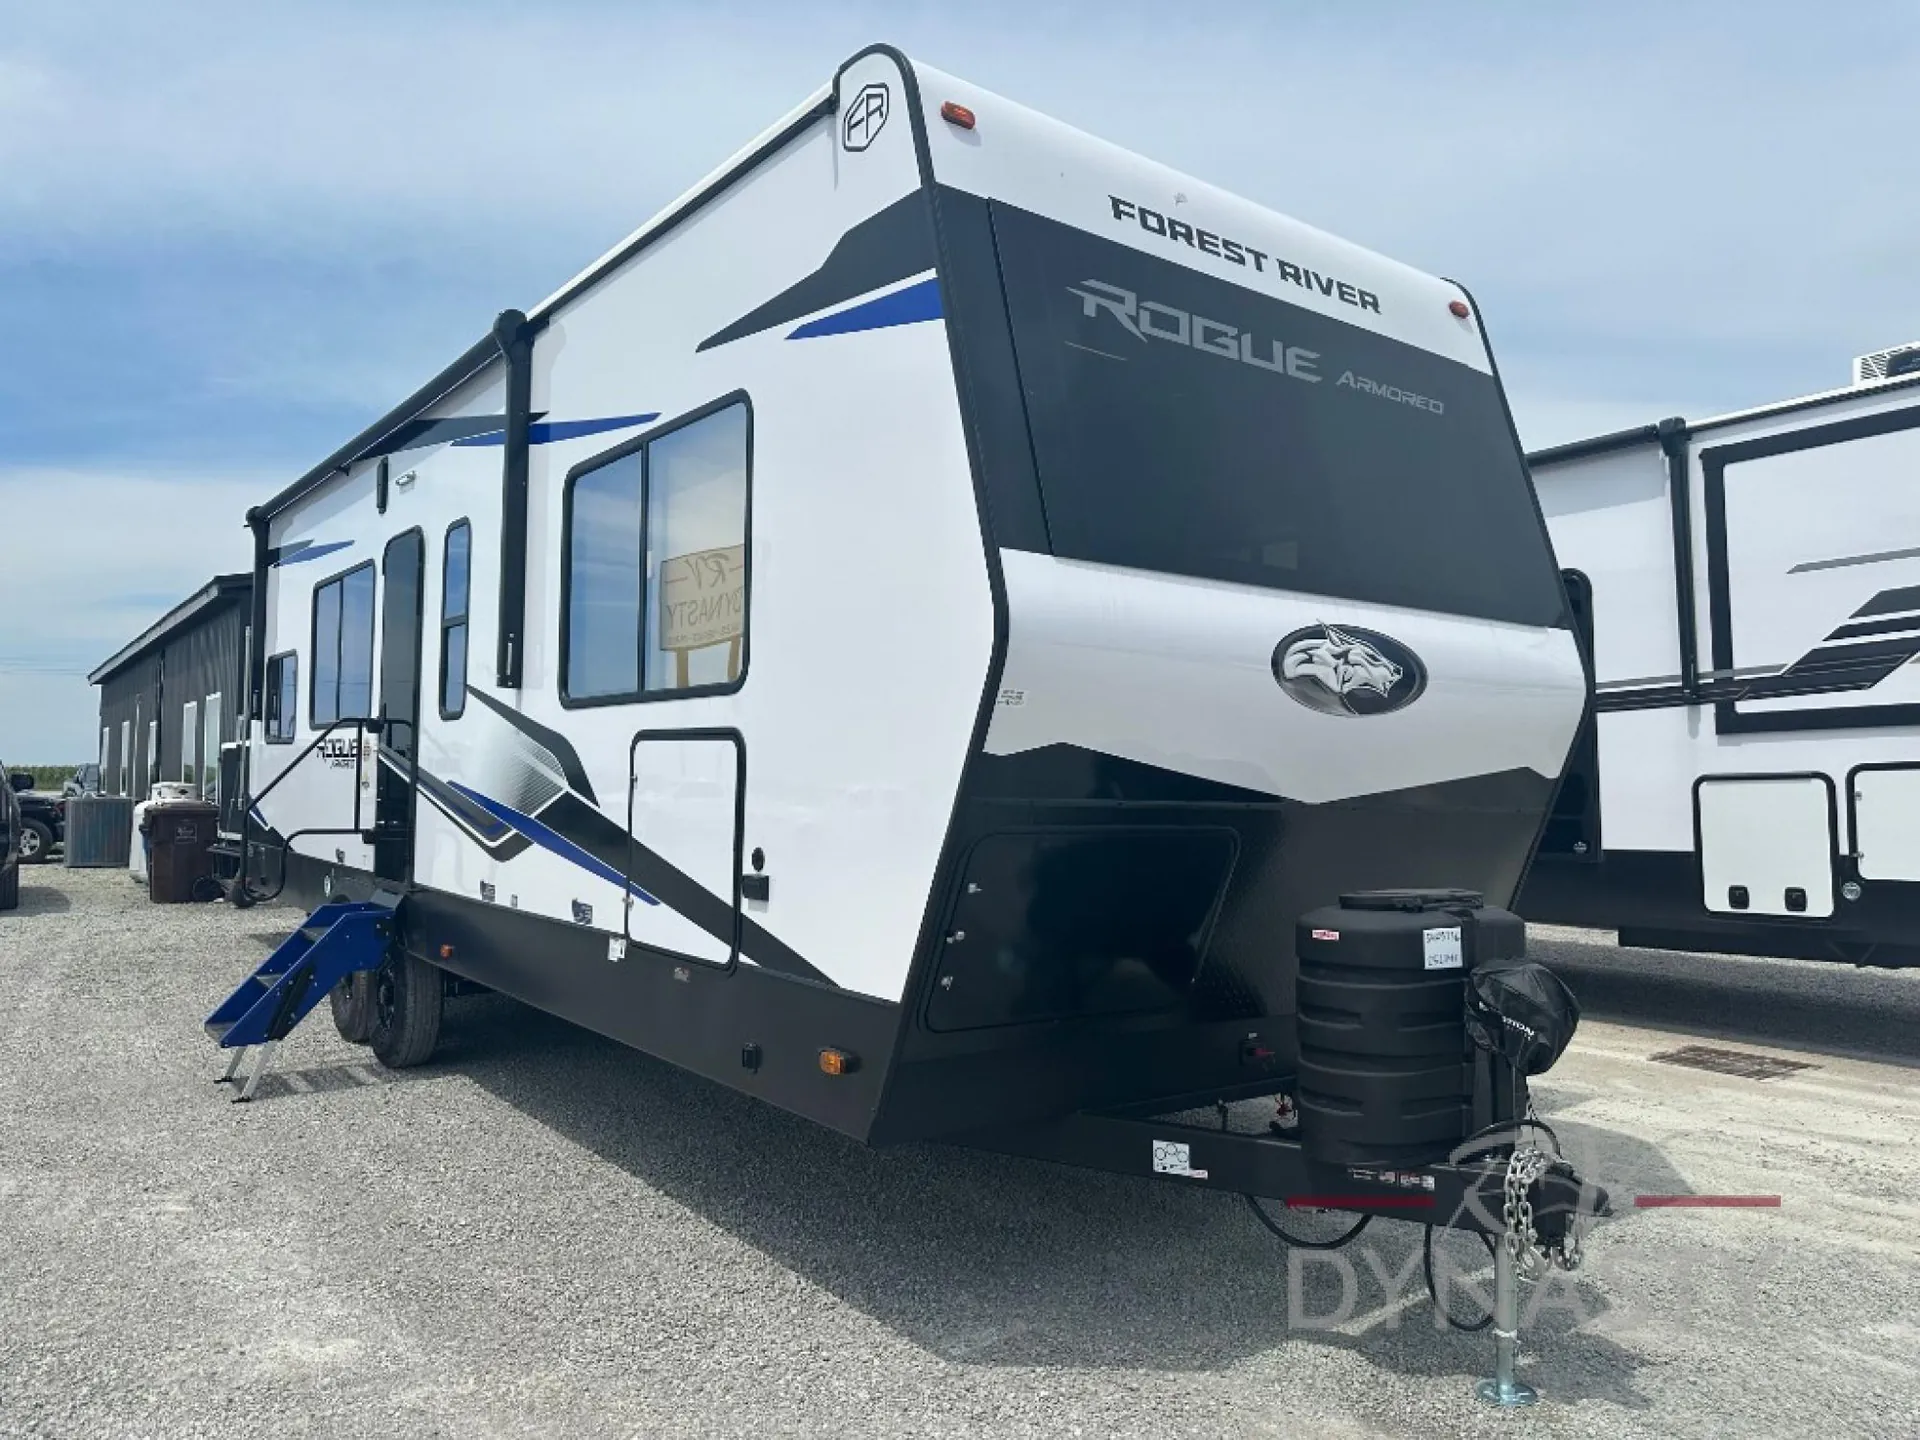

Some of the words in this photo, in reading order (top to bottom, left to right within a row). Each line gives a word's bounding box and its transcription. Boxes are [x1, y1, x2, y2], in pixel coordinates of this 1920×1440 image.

[1108, 194, 1268, 273] FOREST
[1276, 258, 1382, 316] RIVER
[1065, 278, 1323, 384] ROGUE
[1335, 370, 1445, 416] ARMORED
